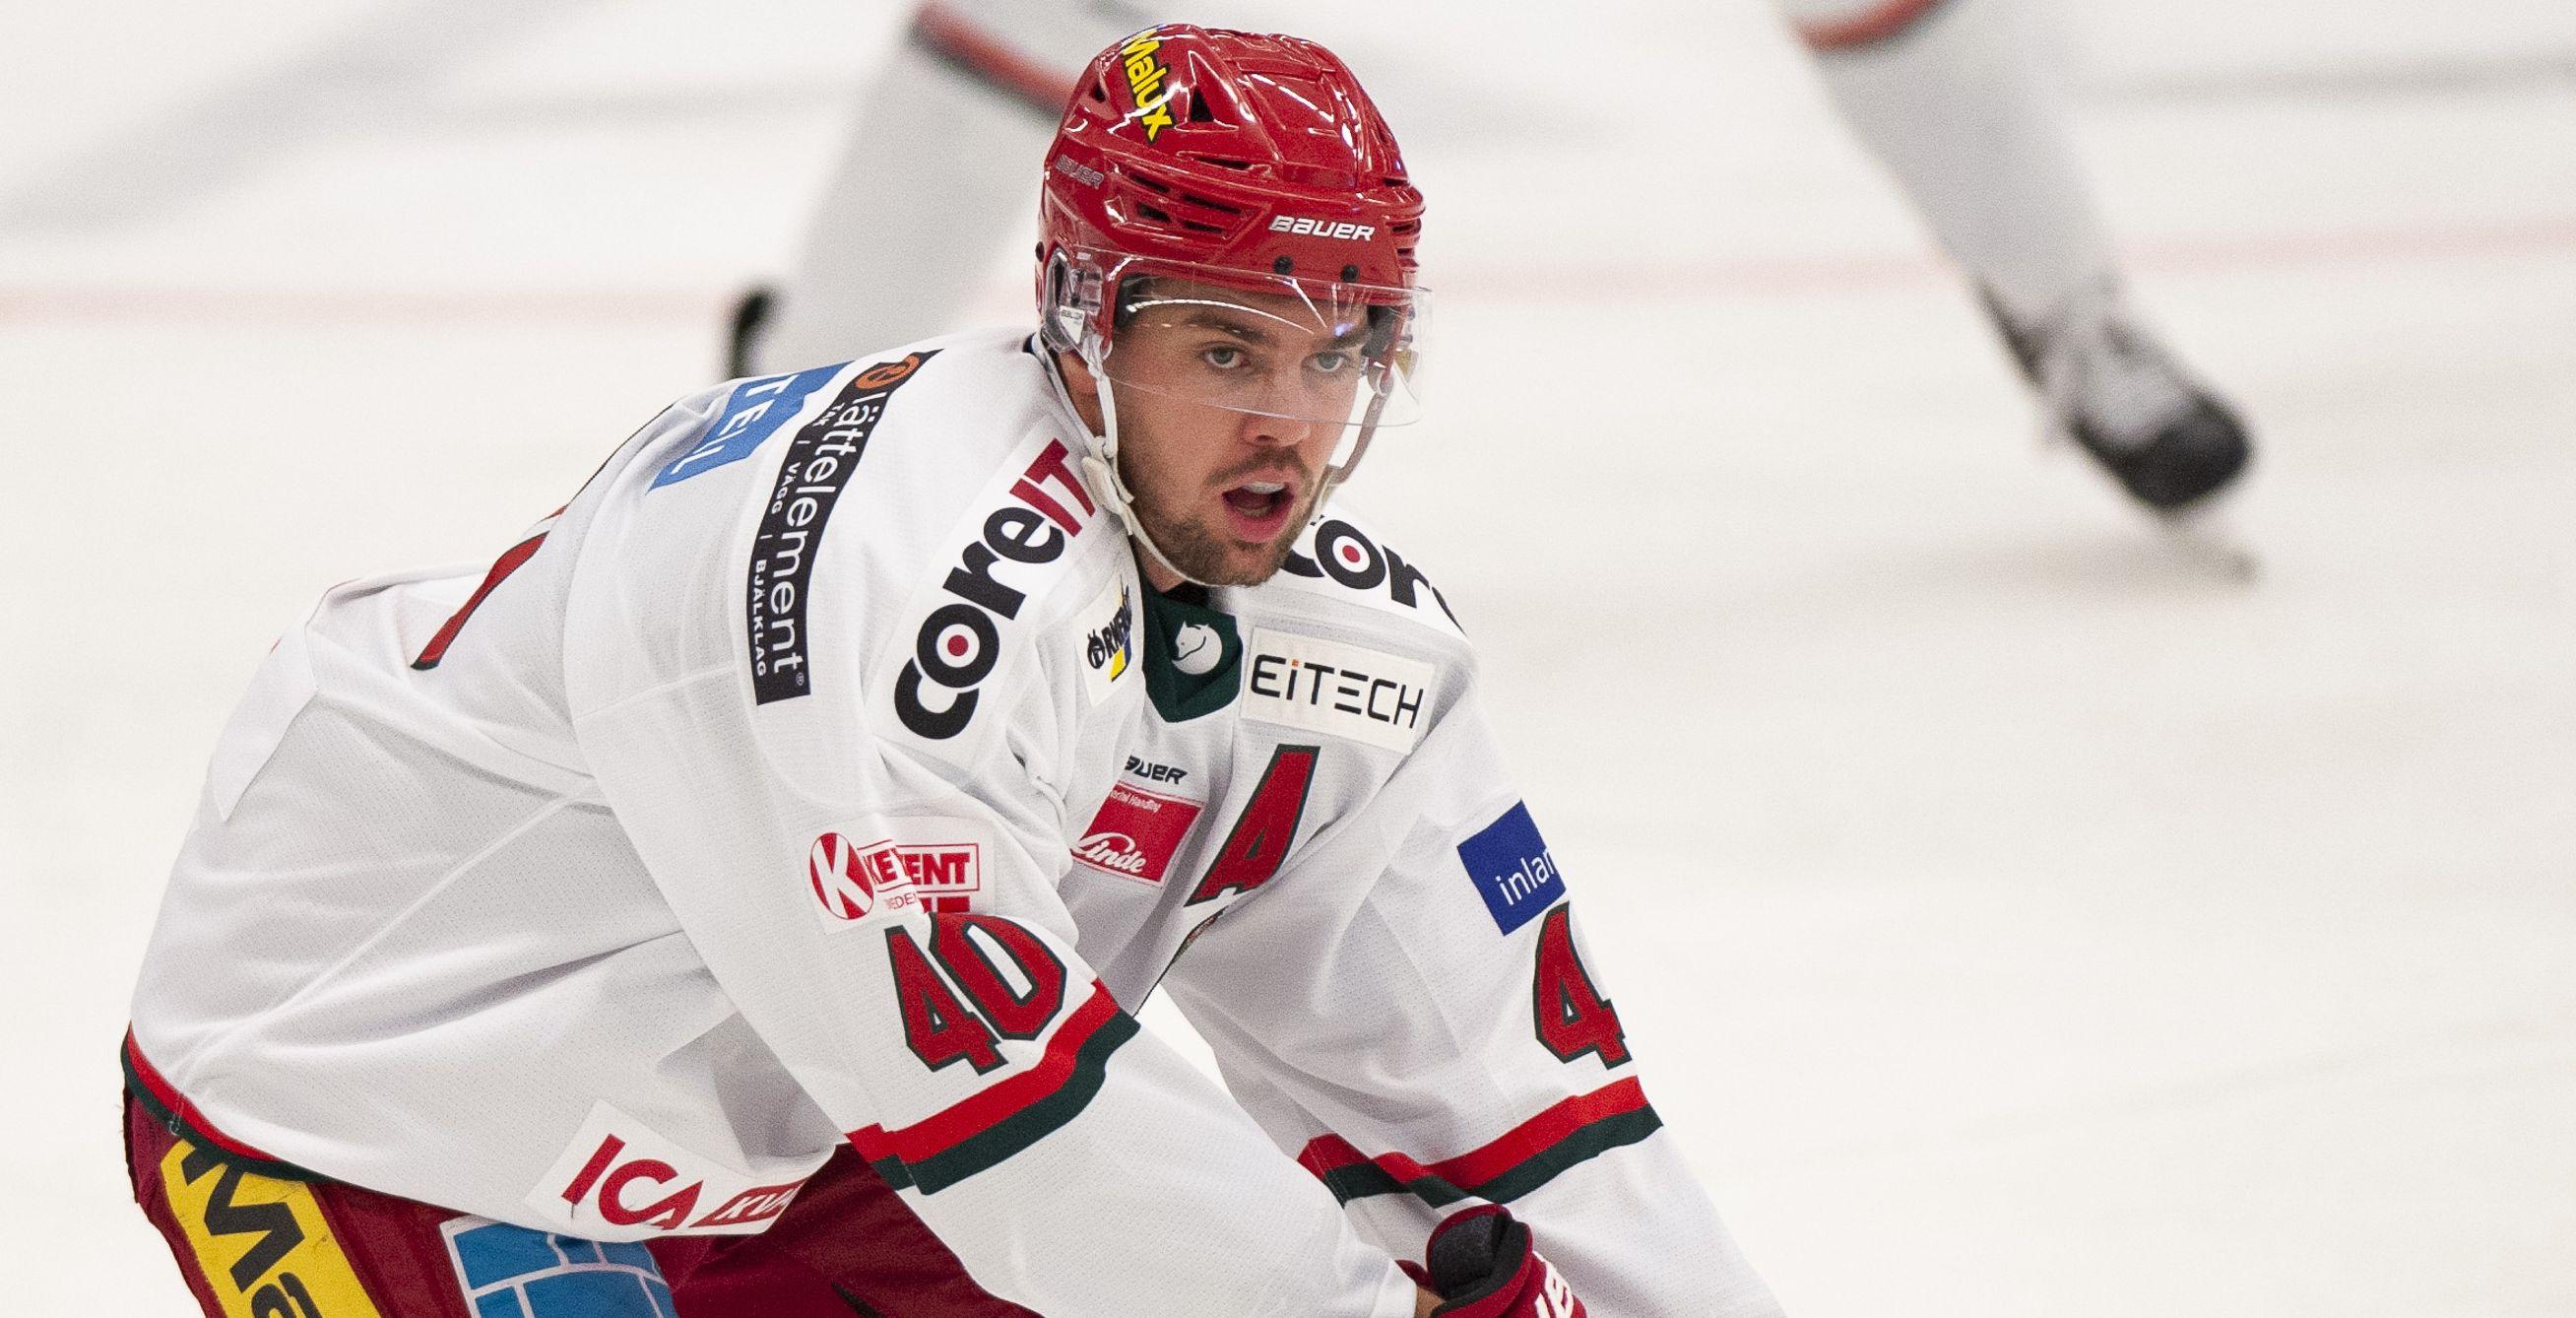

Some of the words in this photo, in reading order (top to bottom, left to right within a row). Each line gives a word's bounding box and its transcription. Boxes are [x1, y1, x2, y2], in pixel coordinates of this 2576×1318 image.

[1122, 29, 1173, 142] Malux
[1267, 214, 1376, 241] BAUER
[894, 437, 1096, 740] coreIT
[1070, 831, 1147, 874] Linde
[1183, 743, 1321, 908] A
[884, 910, 1068, 1077] 40
[1532, 900, 1633, 1071] 4
[560, 1133, 704, 1230] ICA
